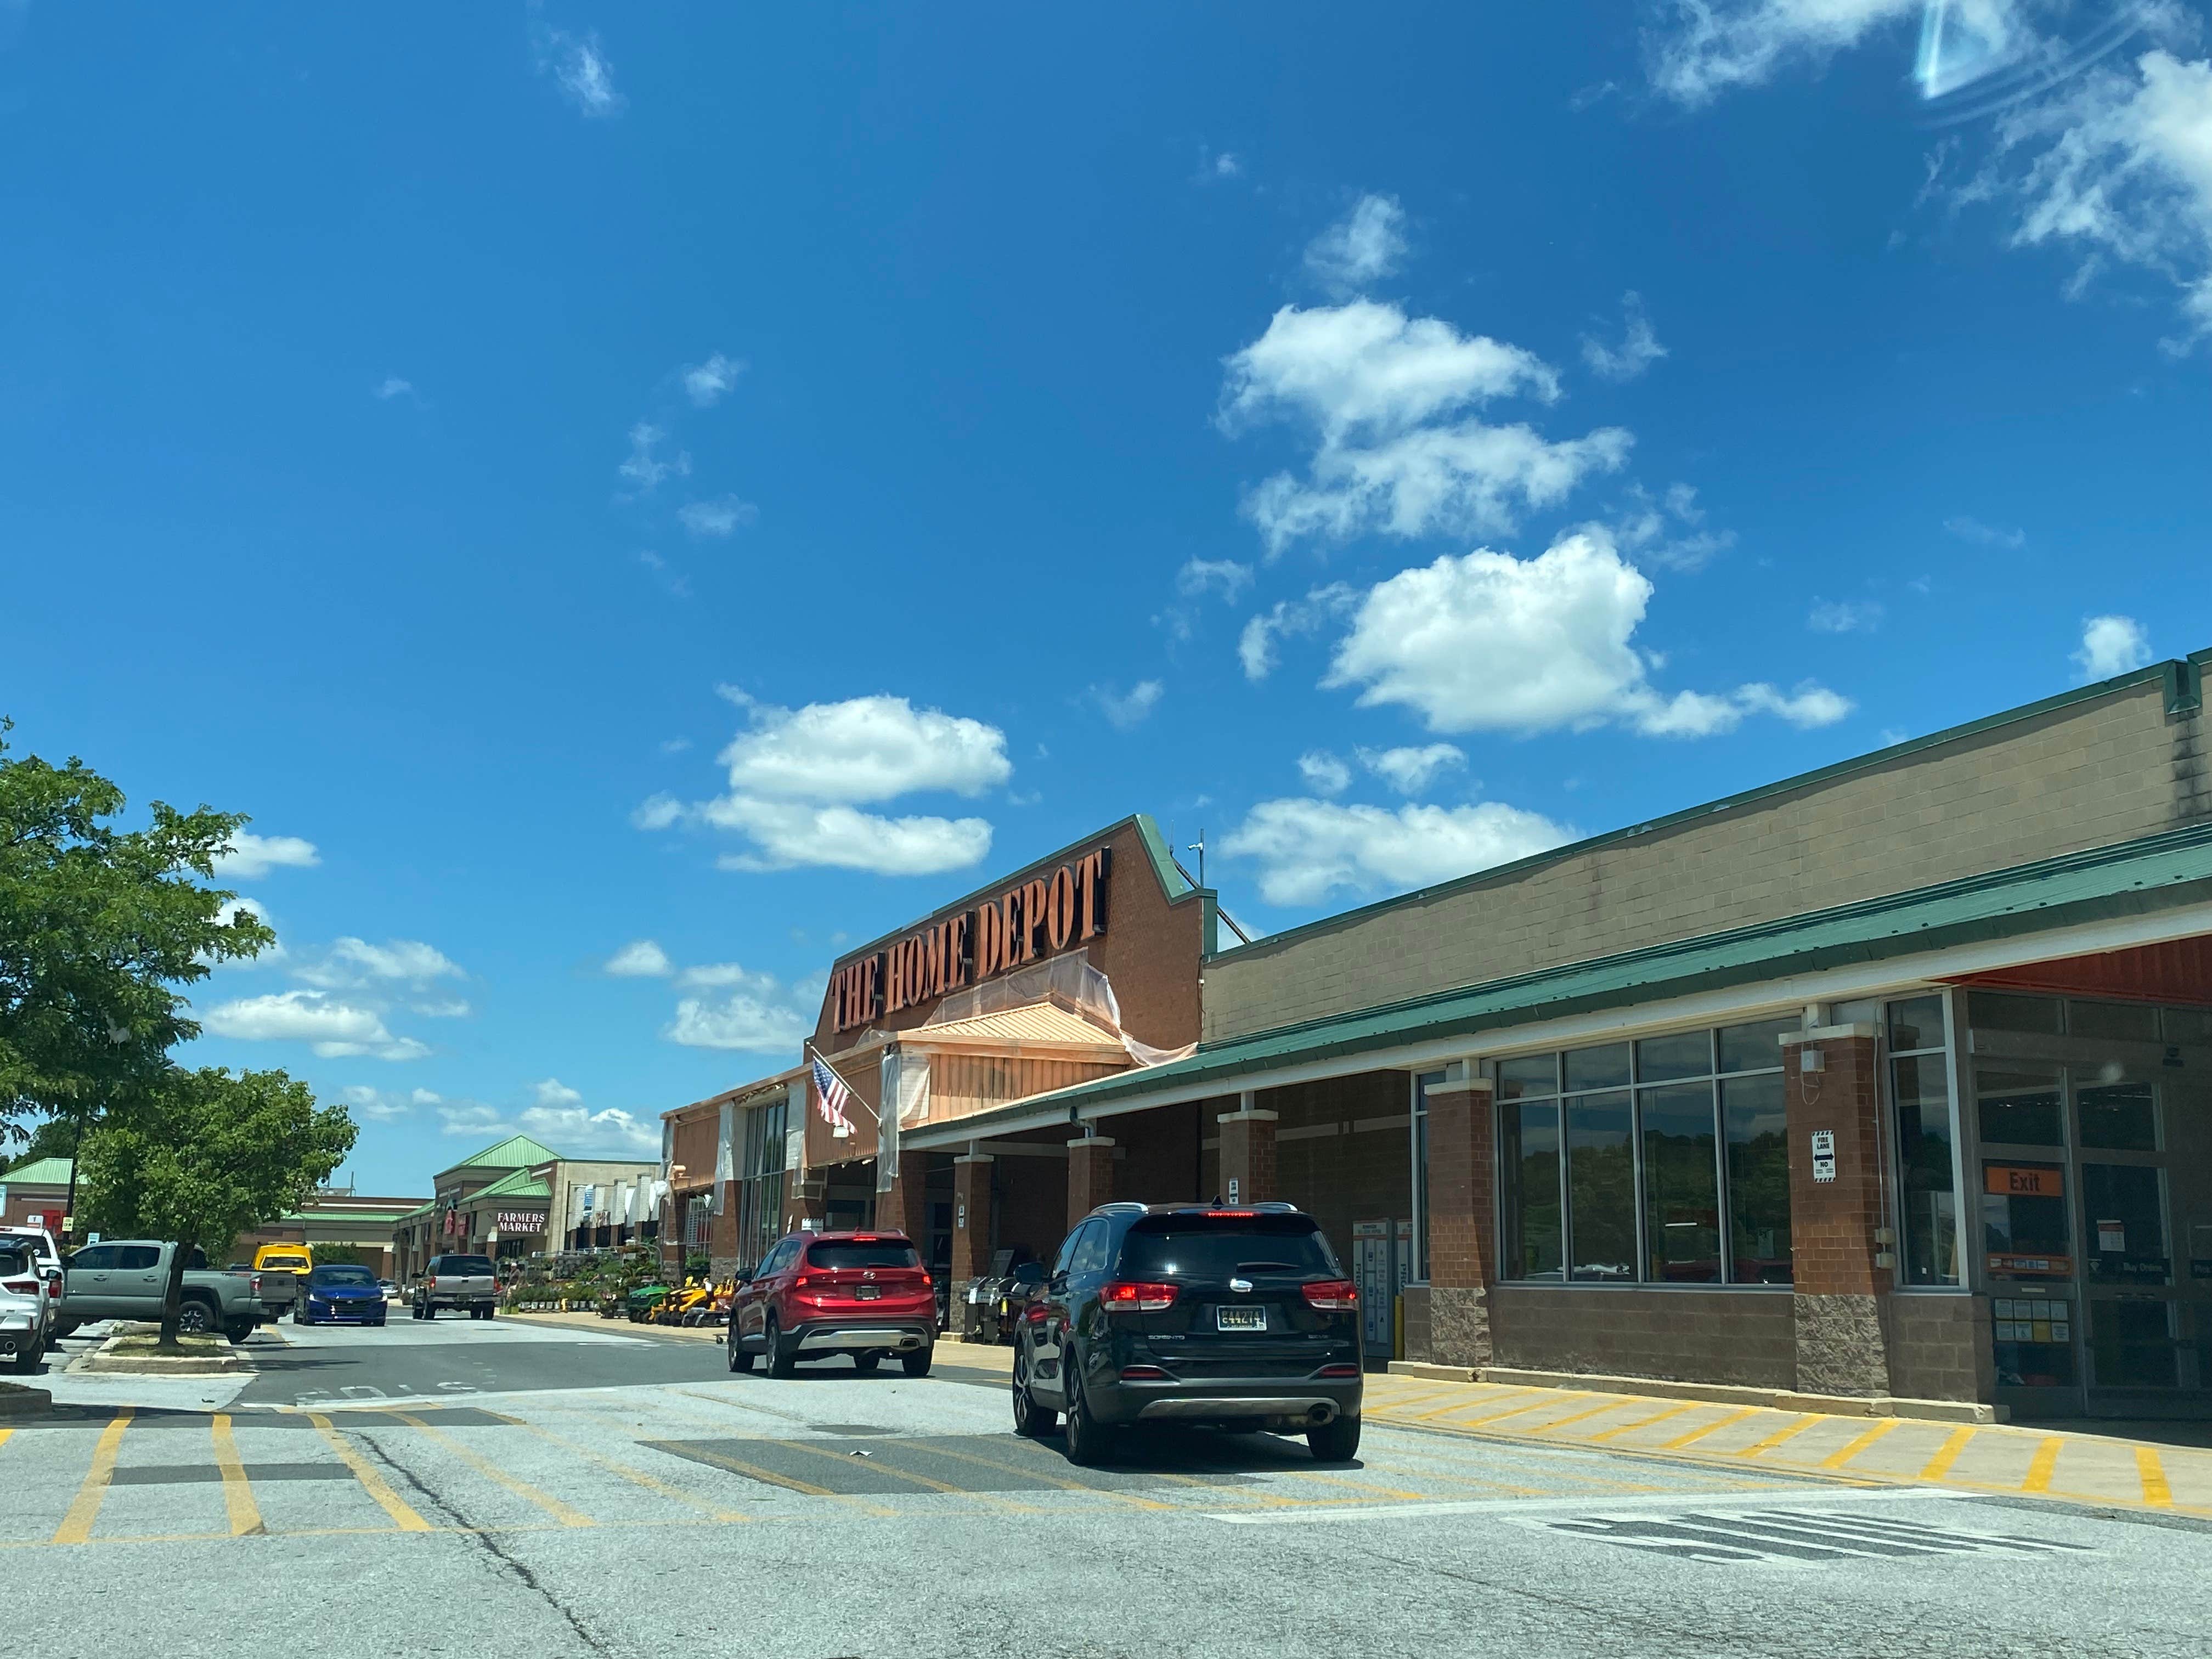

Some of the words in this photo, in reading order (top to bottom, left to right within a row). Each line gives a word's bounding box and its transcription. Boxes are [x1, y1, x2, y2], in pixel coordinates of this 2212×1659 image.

[830, 952, 884, 1035] THE
[885, 911, 974, 1013] HOME
[977, 849, 1110, 979] DEPOT
[2010, 1171, 2040, 1191] Exit
[497, 1212, 545, 1222] FARMERS
[499, 1222, 541, 1232] MARKET
